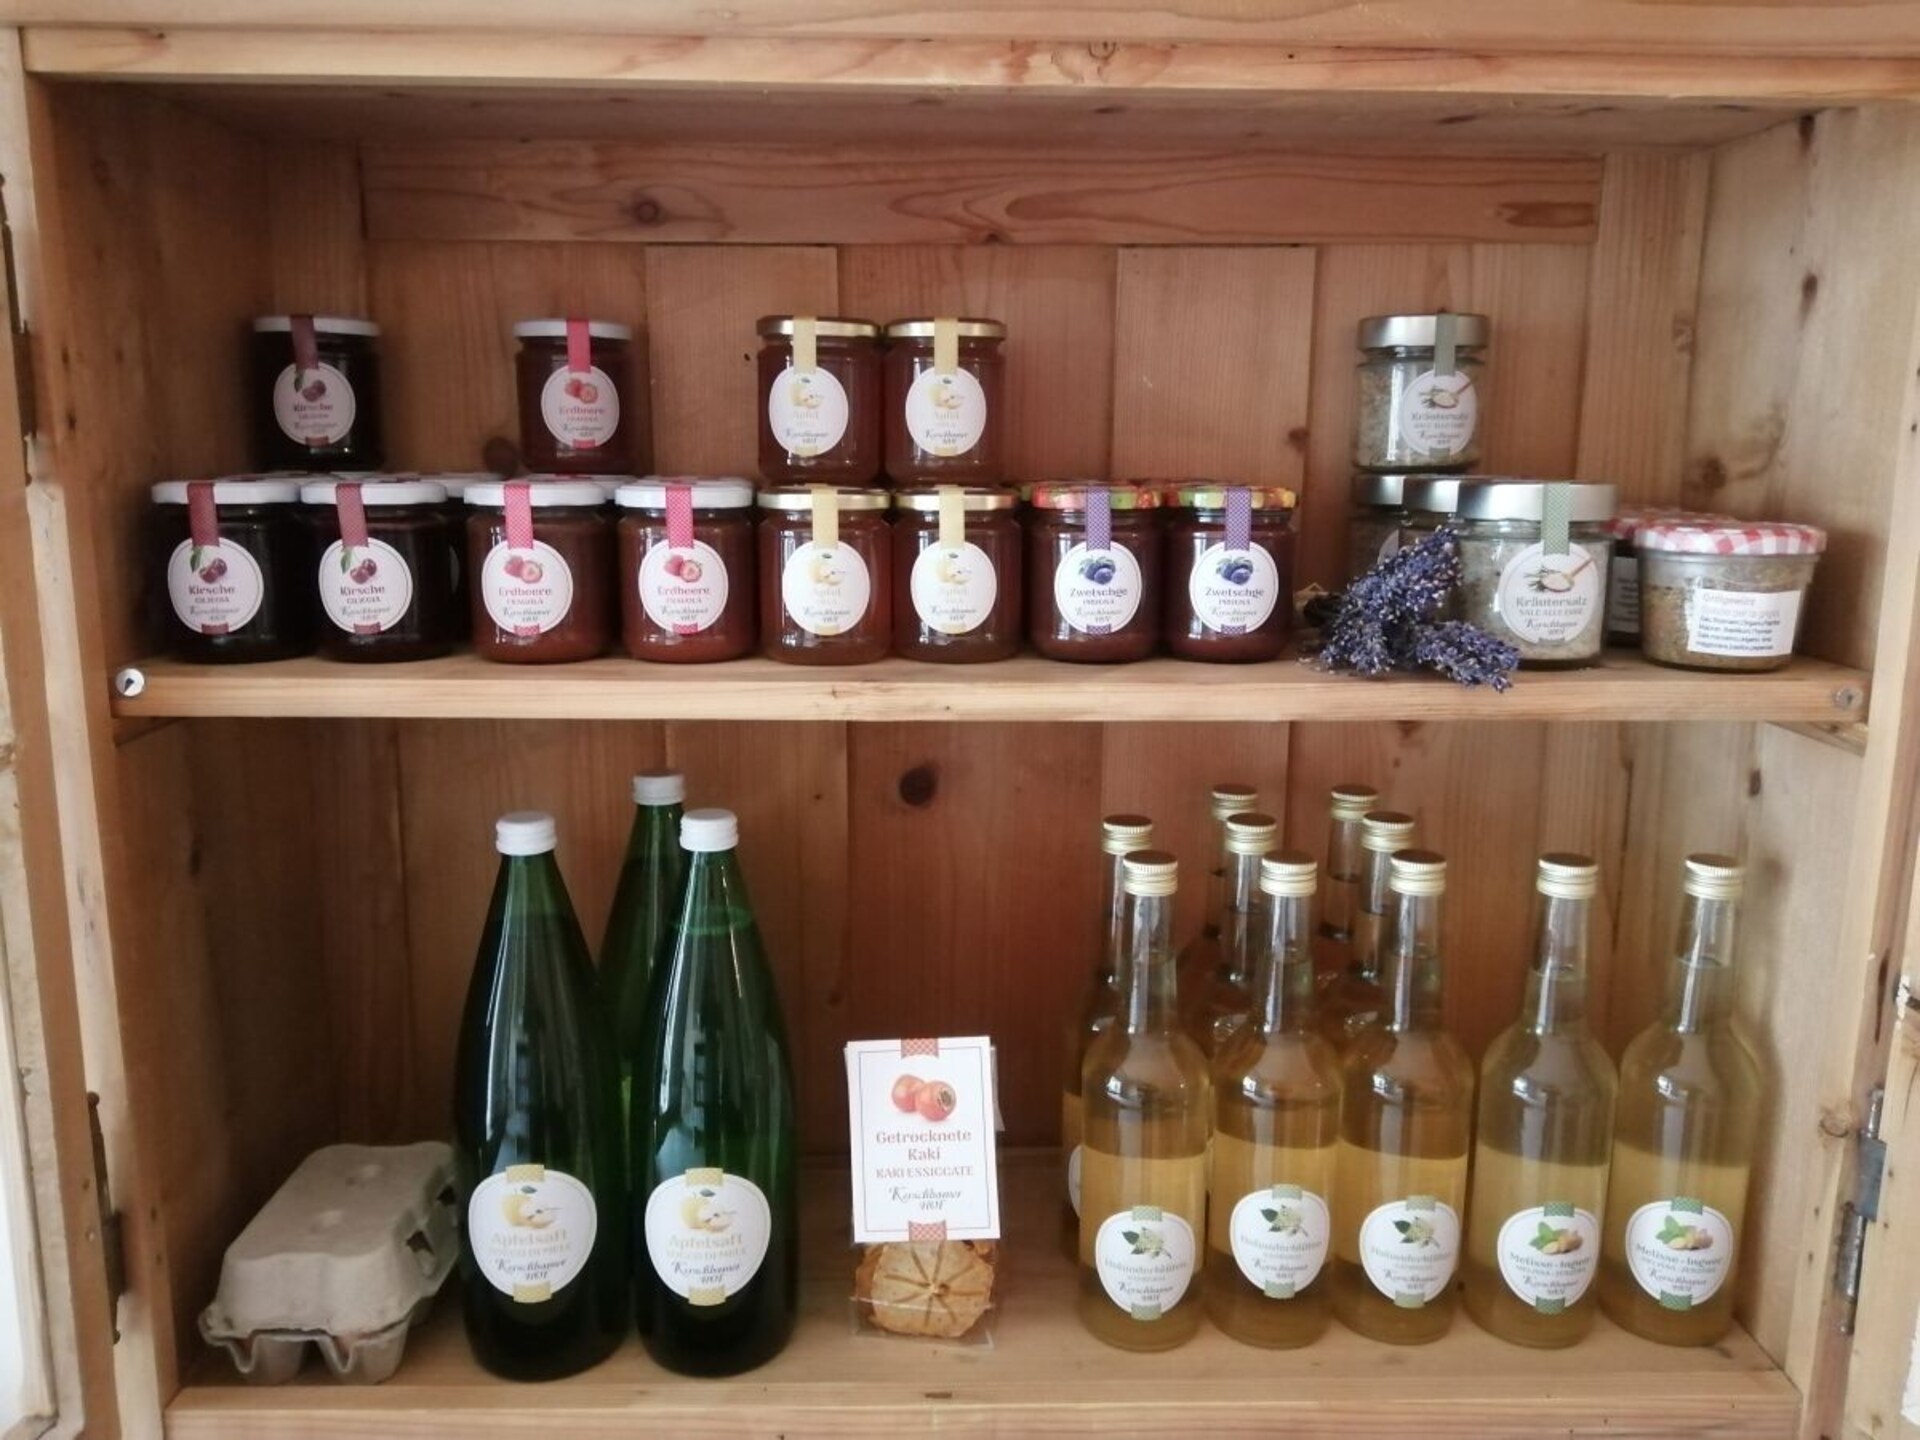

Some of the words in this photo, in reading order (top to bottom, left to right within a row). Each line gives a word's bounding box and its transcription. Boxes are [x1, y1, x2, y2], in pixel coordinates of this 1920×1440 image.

[189, 585, 235, 595] Kirsche
[340, 585, 385, 596] Kirsche
[499, 587, 552, 596] Erdbeere
[657, 586, 710, 596] Erdbeere
[1070, 587, 1128, 598] Zwetschge
[1205, 587, 1265, 598] Zwetschge
[1516, 595, 1587, 607] Kräutersalz
[876, 1129, 972, 1144] Getrocknete
[908, 1147, 940, 1161] Kaki
[875, 1168, 905, 1179] KAKI
[491, 1229, 568, 1246] Apfelsaft
[668, 1233, 743, 1250] Apfelsaft
[1636, 1243, 1679, 1263] Melisse
[1510, 1252, 1553, 1268] Melisse
[1560, 1257, 1590, 1270] Ingwer
